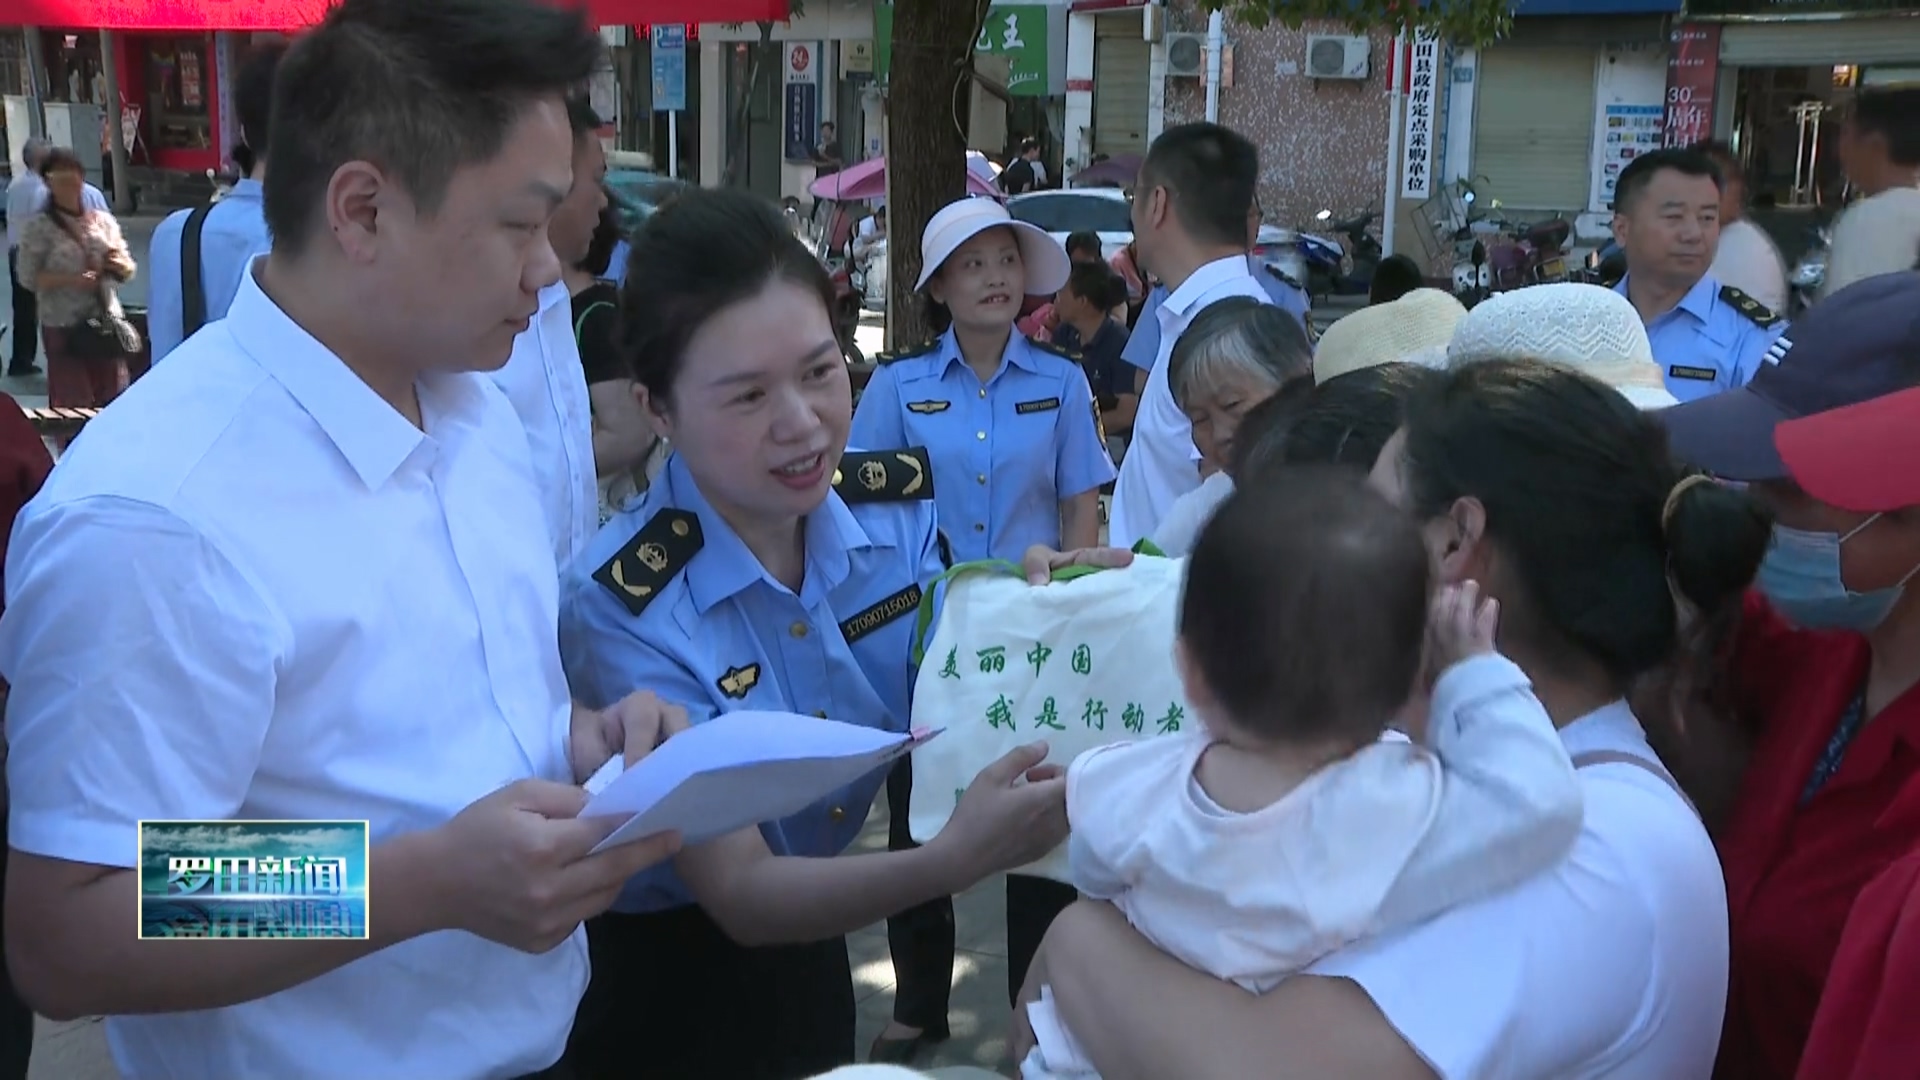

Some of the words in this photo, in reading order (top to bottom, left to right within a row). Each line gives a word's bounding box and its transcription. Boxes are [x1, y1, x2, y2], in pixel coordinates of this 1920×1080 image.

[1667, 86, 1691, 103] 30
[846, 590, 919, 637] 17090715018
[938, 641, 1092, 680] 美丽中国
[984, 694, 1186, 736] 我是行动者
